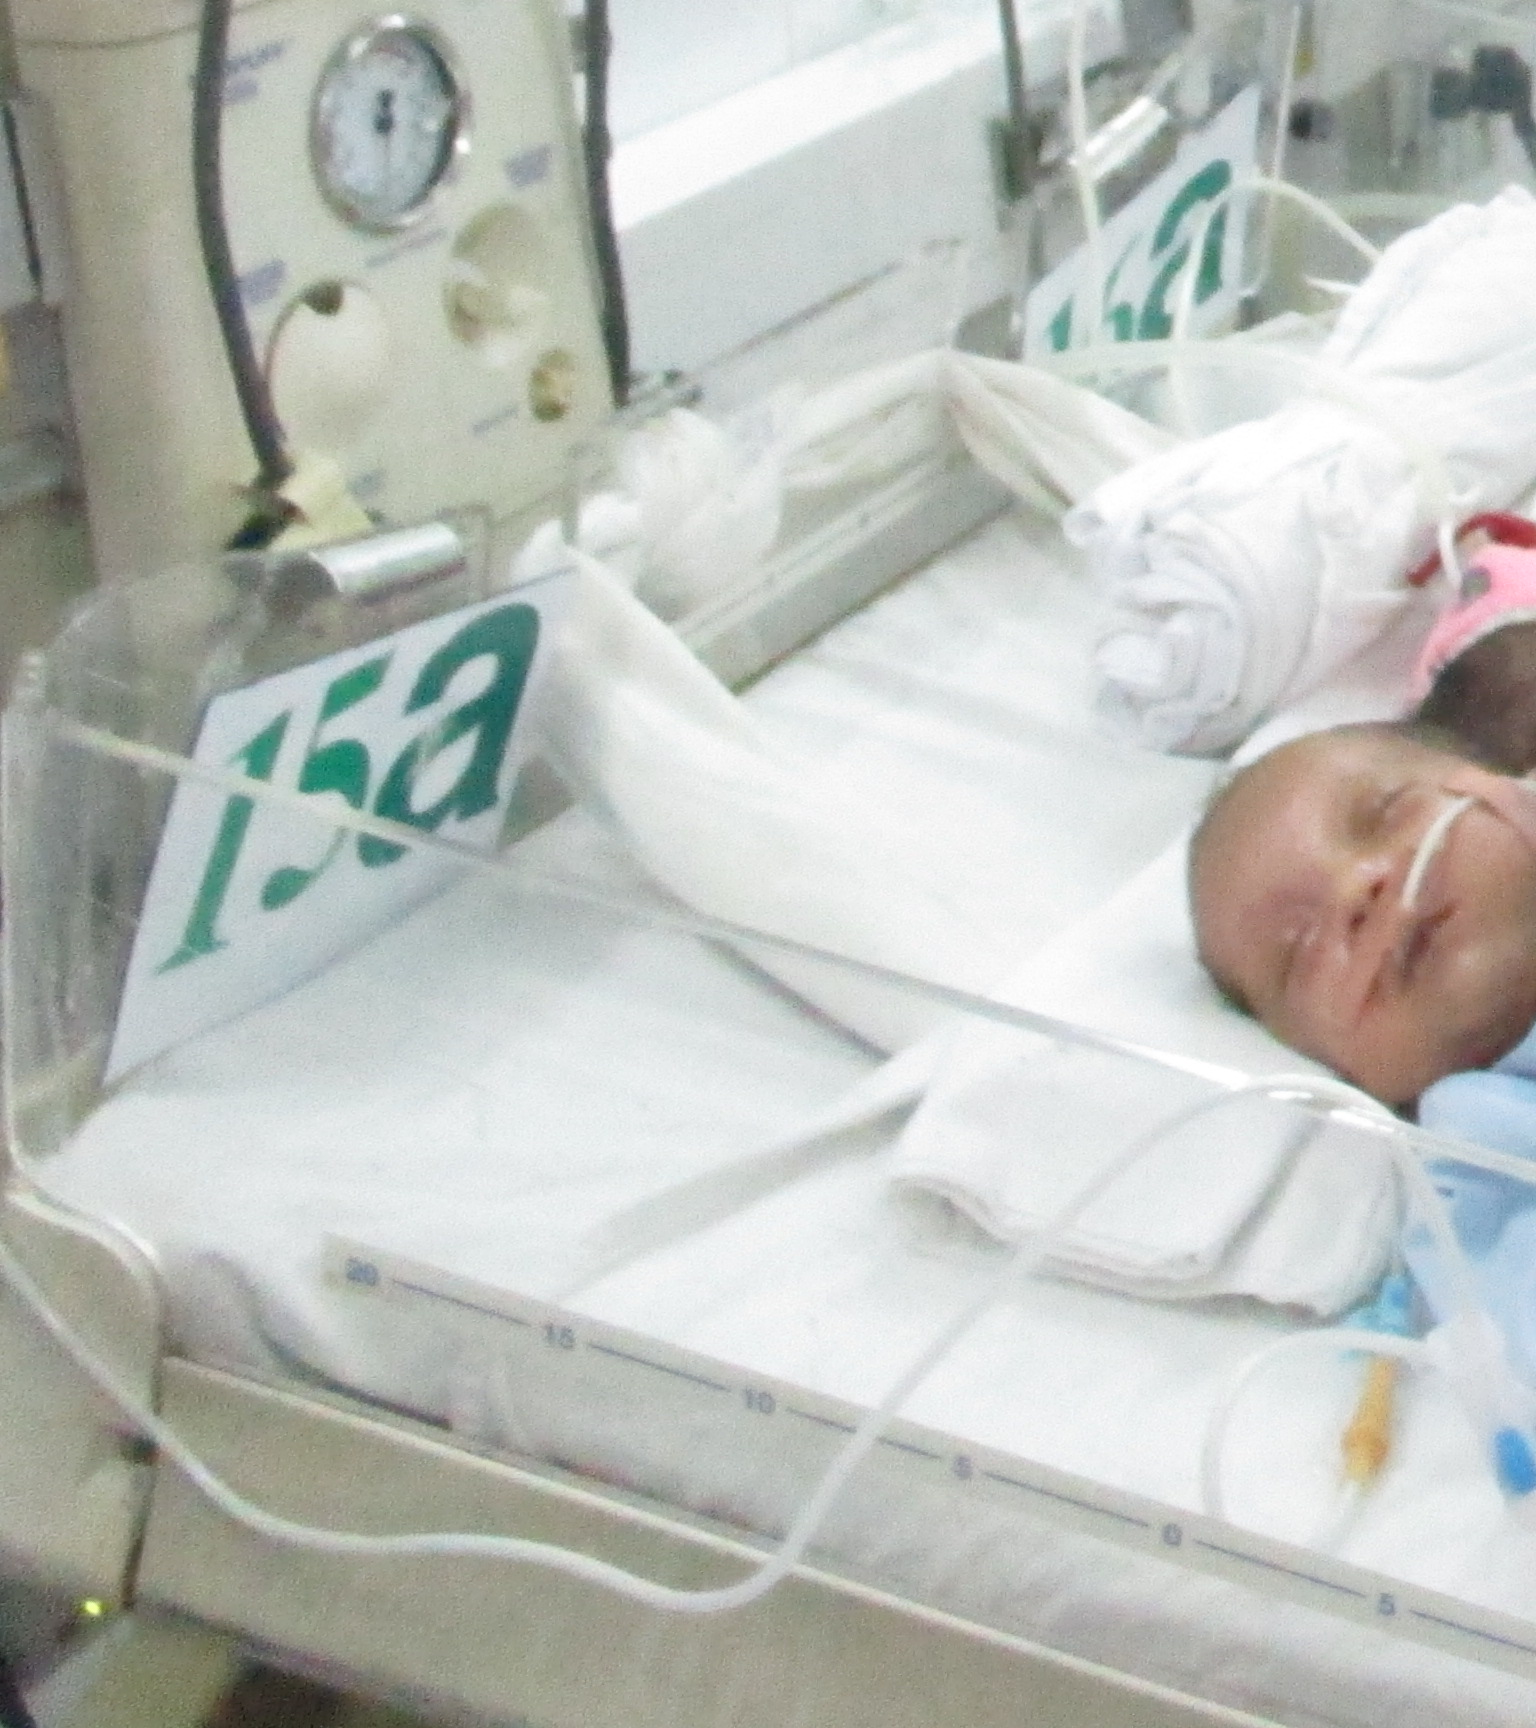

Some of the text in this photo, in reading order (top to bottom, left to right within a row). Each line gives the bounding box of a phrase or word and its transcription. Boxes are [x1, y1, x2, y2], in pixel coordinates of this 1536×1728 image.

[155, 602, 541, 974] 15a
[743, 1385, 777, 1415] 10
[1161, 1522, 1183, 1547] 0
[1377, 1592, 1396, 1617] 5
